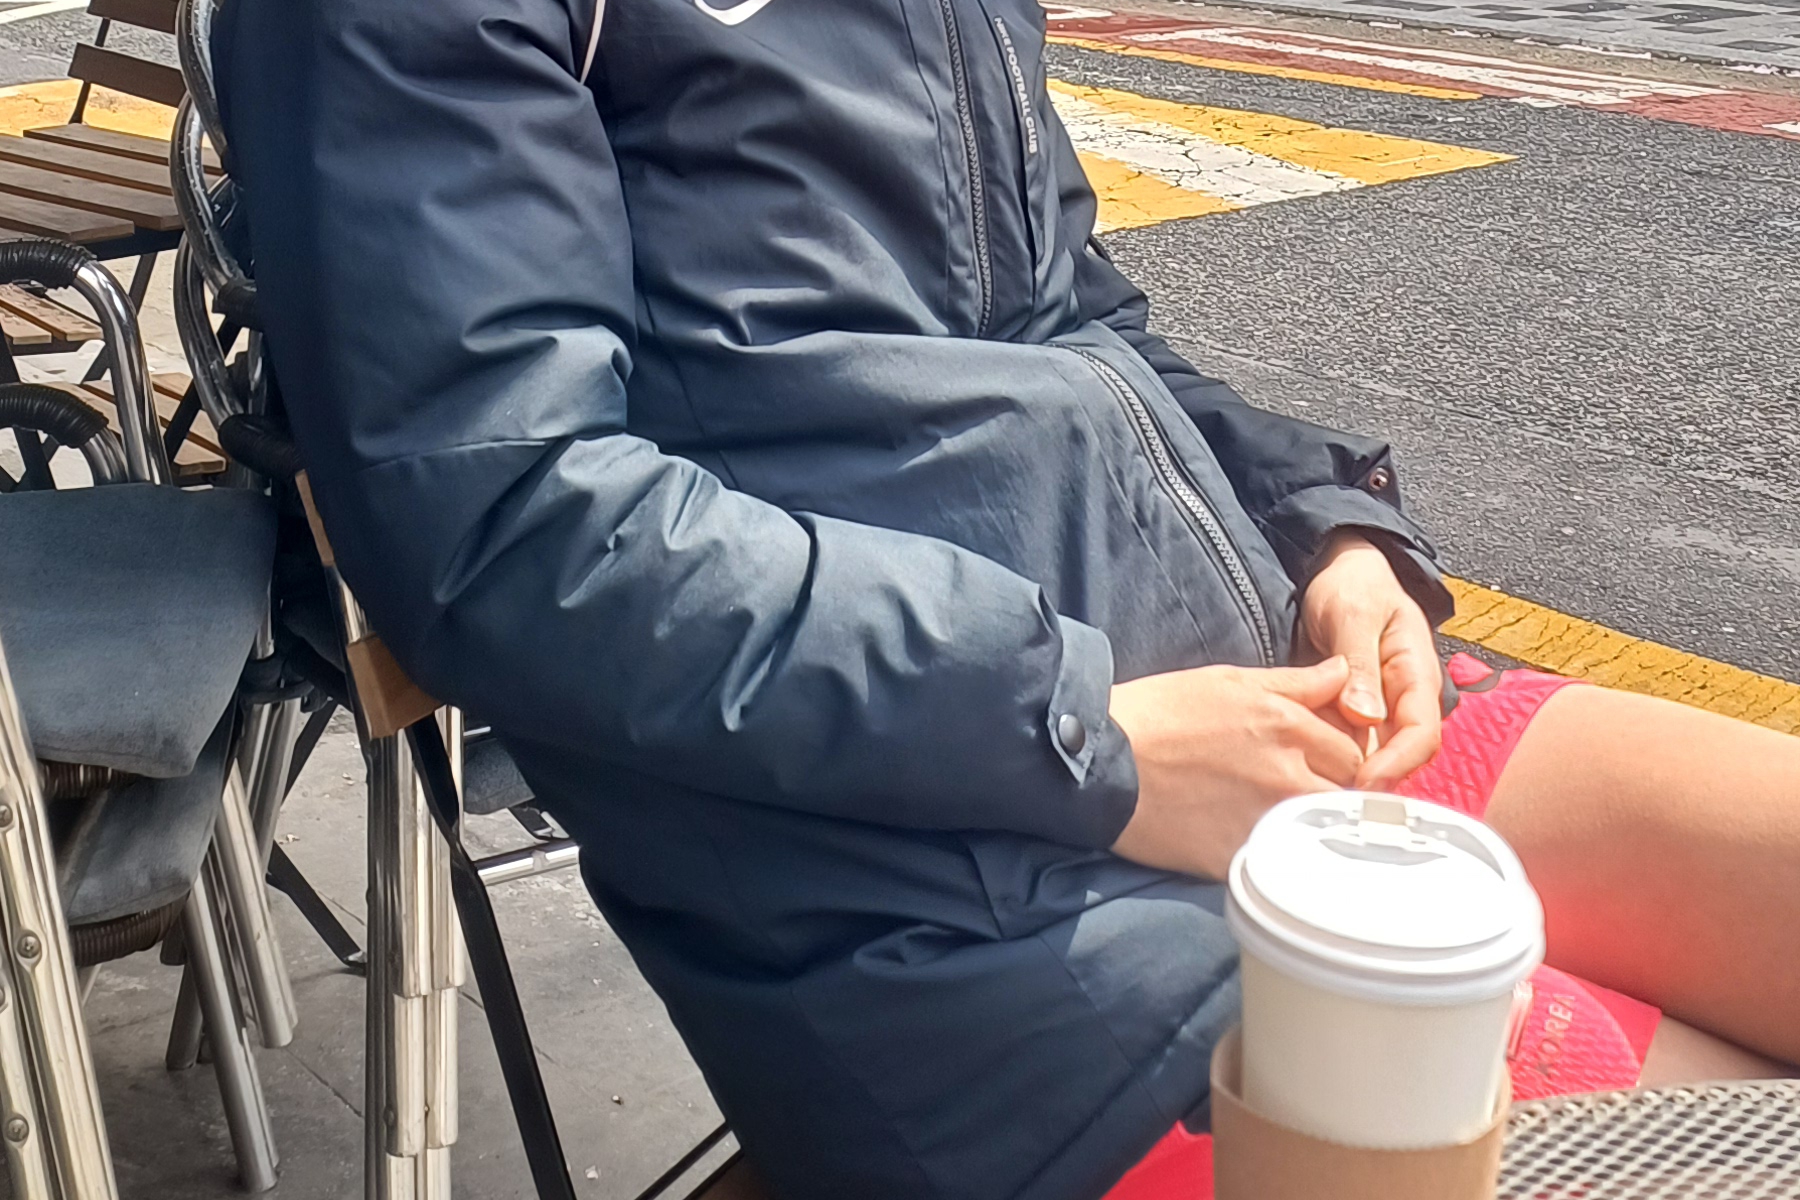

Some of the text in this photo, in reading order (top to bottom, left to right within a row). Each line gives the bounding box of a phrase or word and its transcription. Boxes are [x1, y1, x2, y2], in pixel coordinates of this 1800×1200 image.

[994, 16, 1038, 154] NIKE FOOTBALL CLUB
